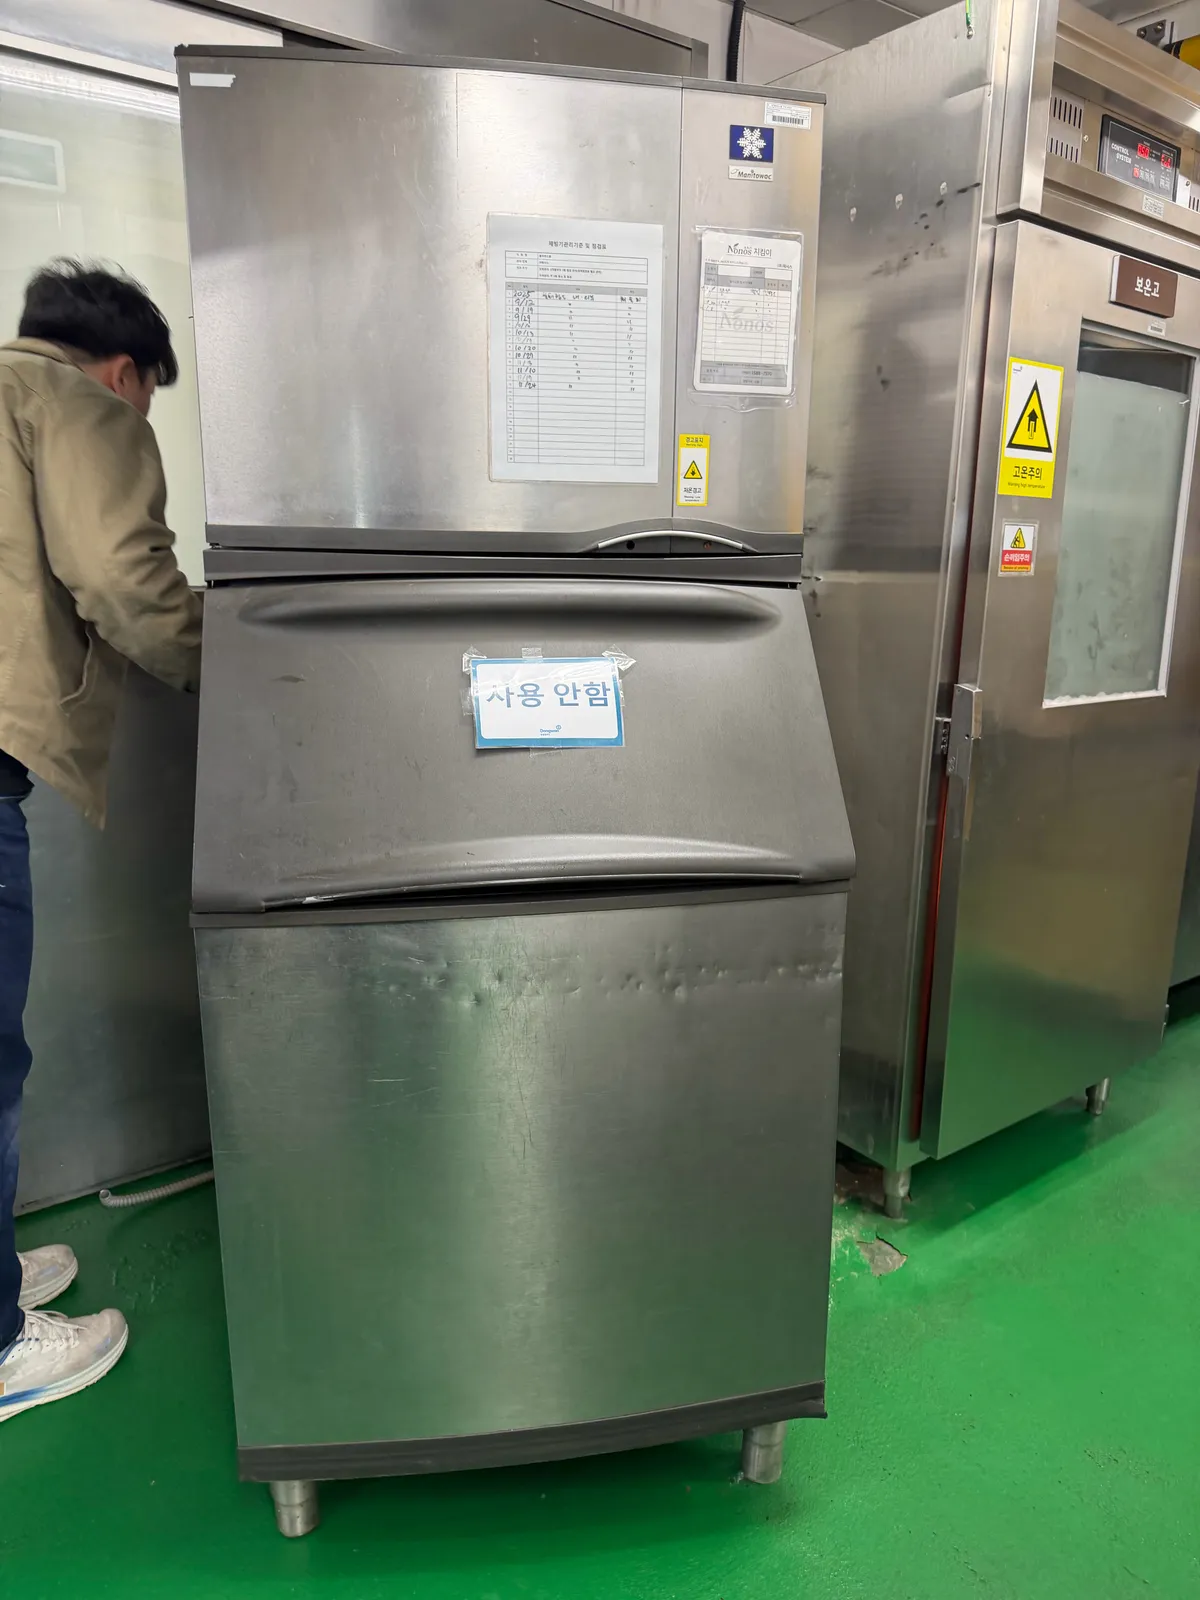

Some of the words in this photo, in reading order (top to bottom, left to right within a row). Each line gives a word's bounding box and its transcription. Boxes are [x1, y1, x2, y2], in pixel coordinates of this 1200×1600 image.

[1111, 143, 1129, 155] CONTROL
[1116, 153, 1131, 164] SYSTEM
[726, 243, 752, 256] Nonos
[1135, 276, 1160, 297] 보온고
[1012, 465, 1043, 481] 고온주의
[486, 682, 544, 708] 사용
[553, 681, 611, 707] 안함
